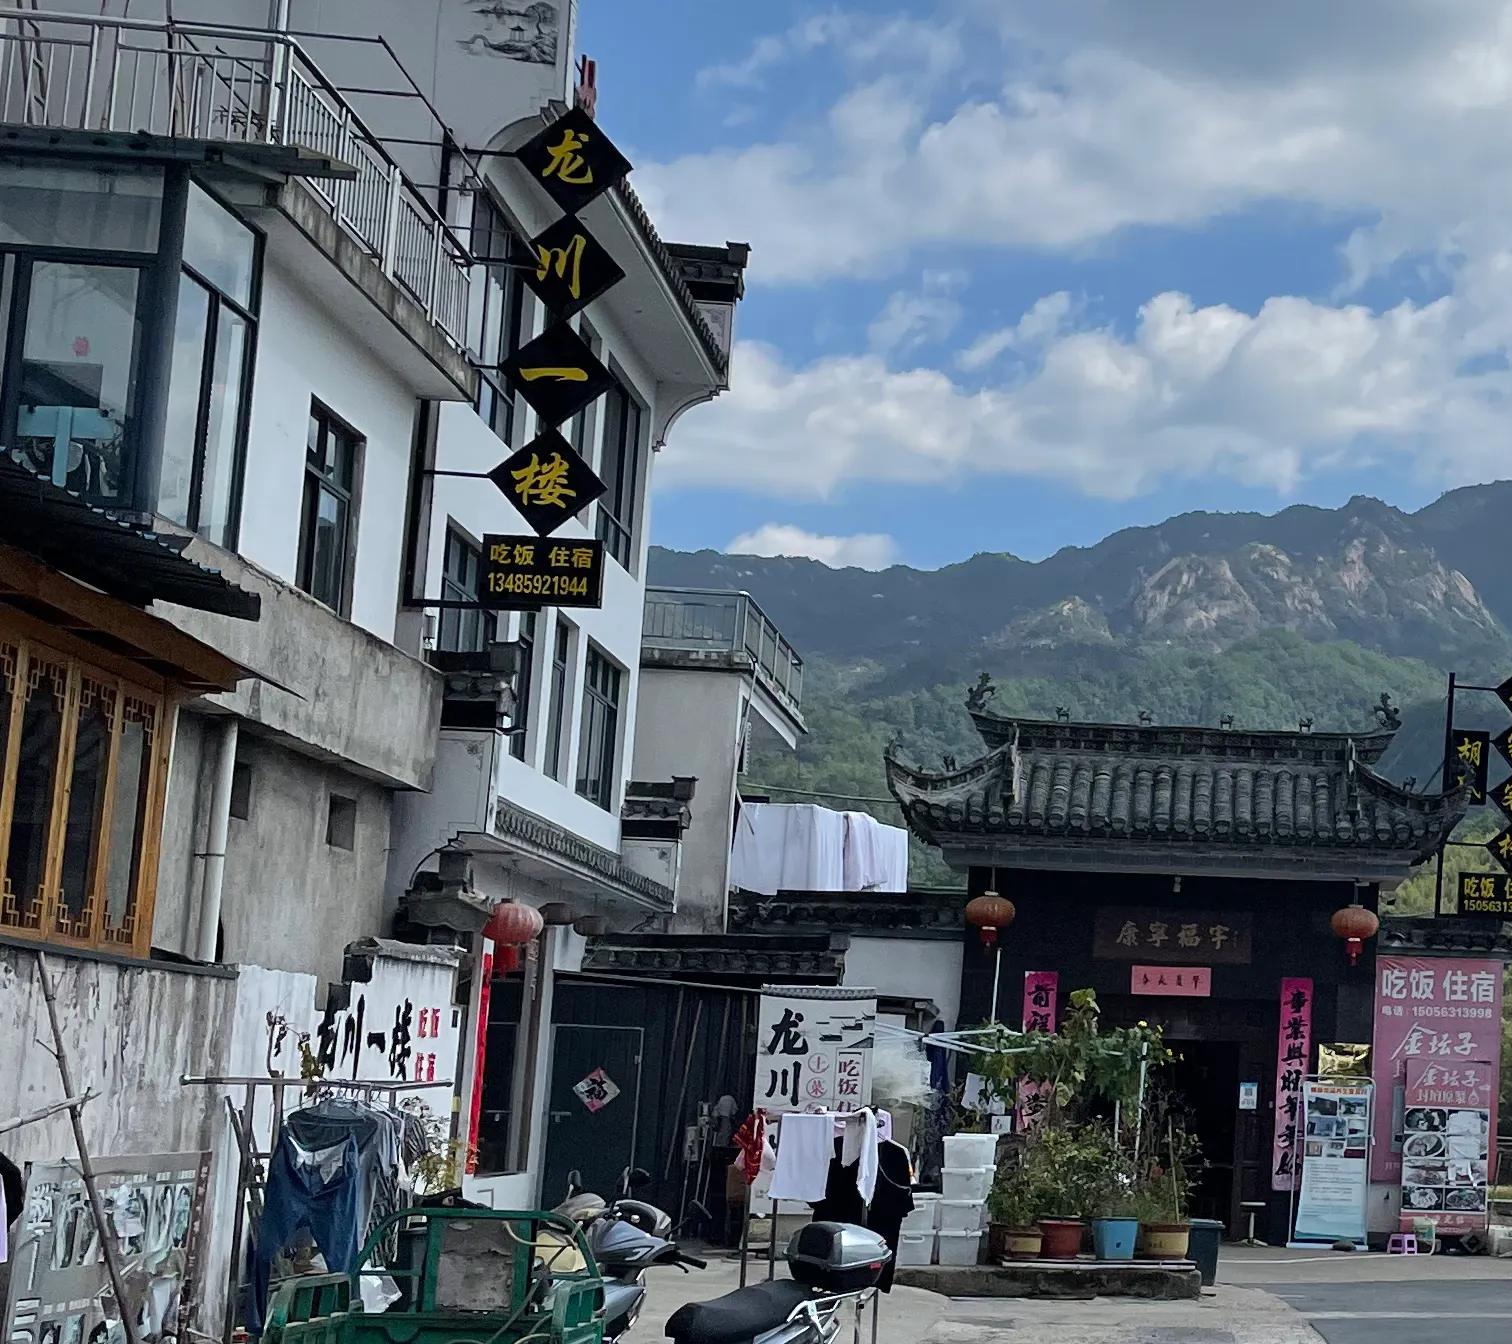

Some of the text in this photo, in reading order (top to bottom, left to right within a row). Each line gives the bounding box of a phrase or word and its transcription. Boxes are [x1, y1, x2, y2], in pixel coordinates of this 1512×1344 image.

[511, 129, 593, 508] 龙川一楼
[490, 544, 593, 568] 吃饭 住宿
[488, 572, 588, 596] 13485921944
[1464, 878, 1495, 898] 吃饭
[1382, 969, 1496, 1003] 吃饭 住宿
[1412, 1006, 1493, 1019] 15056313998
[1390, 1022, 1478, 1060] 金坛子
